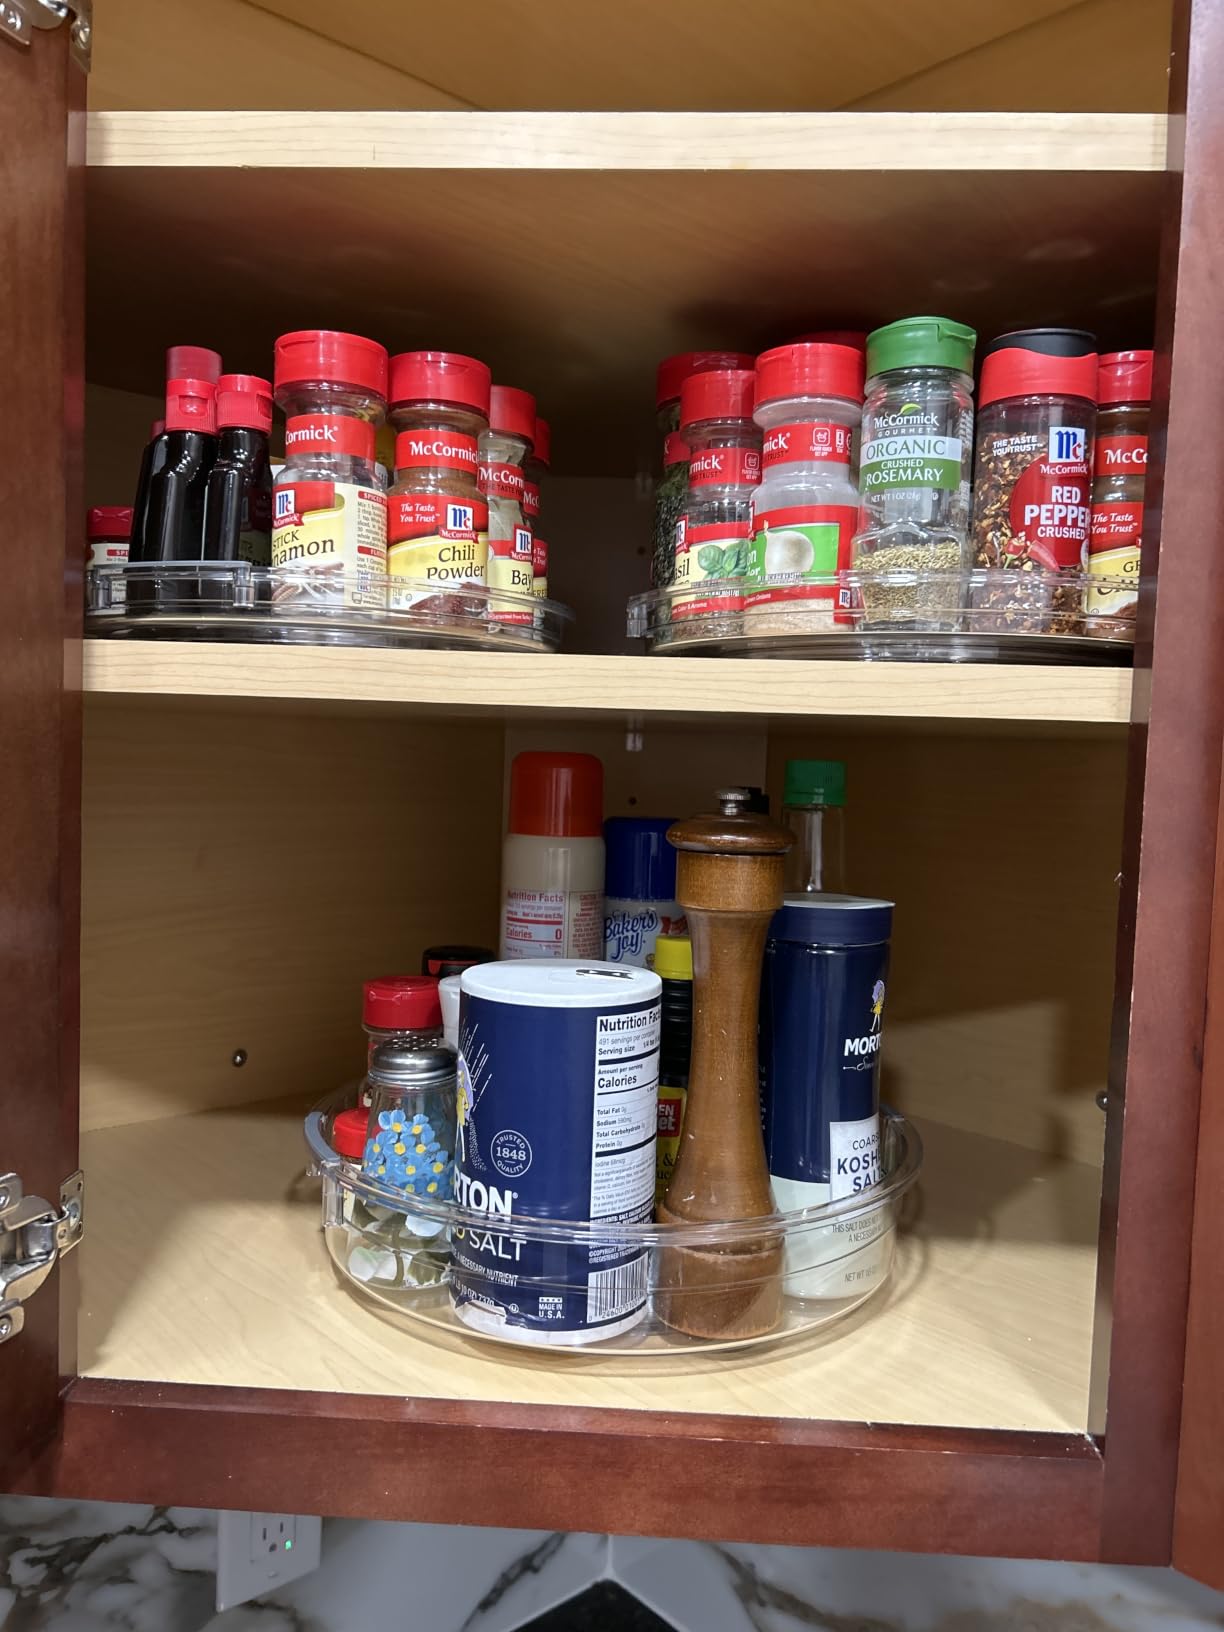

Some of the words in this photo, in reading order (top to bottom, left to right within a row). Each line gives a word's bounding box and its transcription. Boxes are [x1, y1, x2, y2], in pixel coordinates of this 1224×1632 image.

[874, 412, 940, 429] McCormick
[878, 427, 931, 437] GOURMET
[992, 439, 1008, 449] THE
[1009, 435, 1038, 445] TASTE
[866, 439, 945, 460] ORGANIC
[992, 448, 1008, 457] YOU
[881, 459, 924, 469] CRUSHED
[1040, 464, 1088, 475] McCormick
[866, 468, 944, 486] ROSEMARY
[1051, 485, 1081, 504] RED
[401, 502, 413, 512] The
[415, 503, 435, 512] Taste
[400, 514, 413, 523] You
[1093, 513, 1108, 523] The
[1110, 513, 1133, 522] Taste
[441, 529, 476, 539] McCormick
[1037, 526, 1085, 540] CRUSHED
[1091, 524, 1106, 534] You
[438, 544, 475, 562] Chili
[426, 562, 484, 580] Powder
[511, 569, 532, 591] Bay
[539, 893, 564, 902] Facts
[506, 927, 532, 939] Calories
[555, 928, 562, 940] 0
[599, 1015, 647, 1032] Nutrition
[598, 1047, 623, 1055] Serving
[598, 1075, 637, 1088] Calories
[496, 1134, 526, 1149] TRUSTED
[495, 1147, 526, 1161] 1848
[497, 1160, 523, 1173] QUALITY
[832, 1224, 844, 1233] THIS
[846, 1221, 858, 1232] SALT
[469, 1229, 527, 1261] SALT
[539, 1311, 565, 1319] U.S.A.
